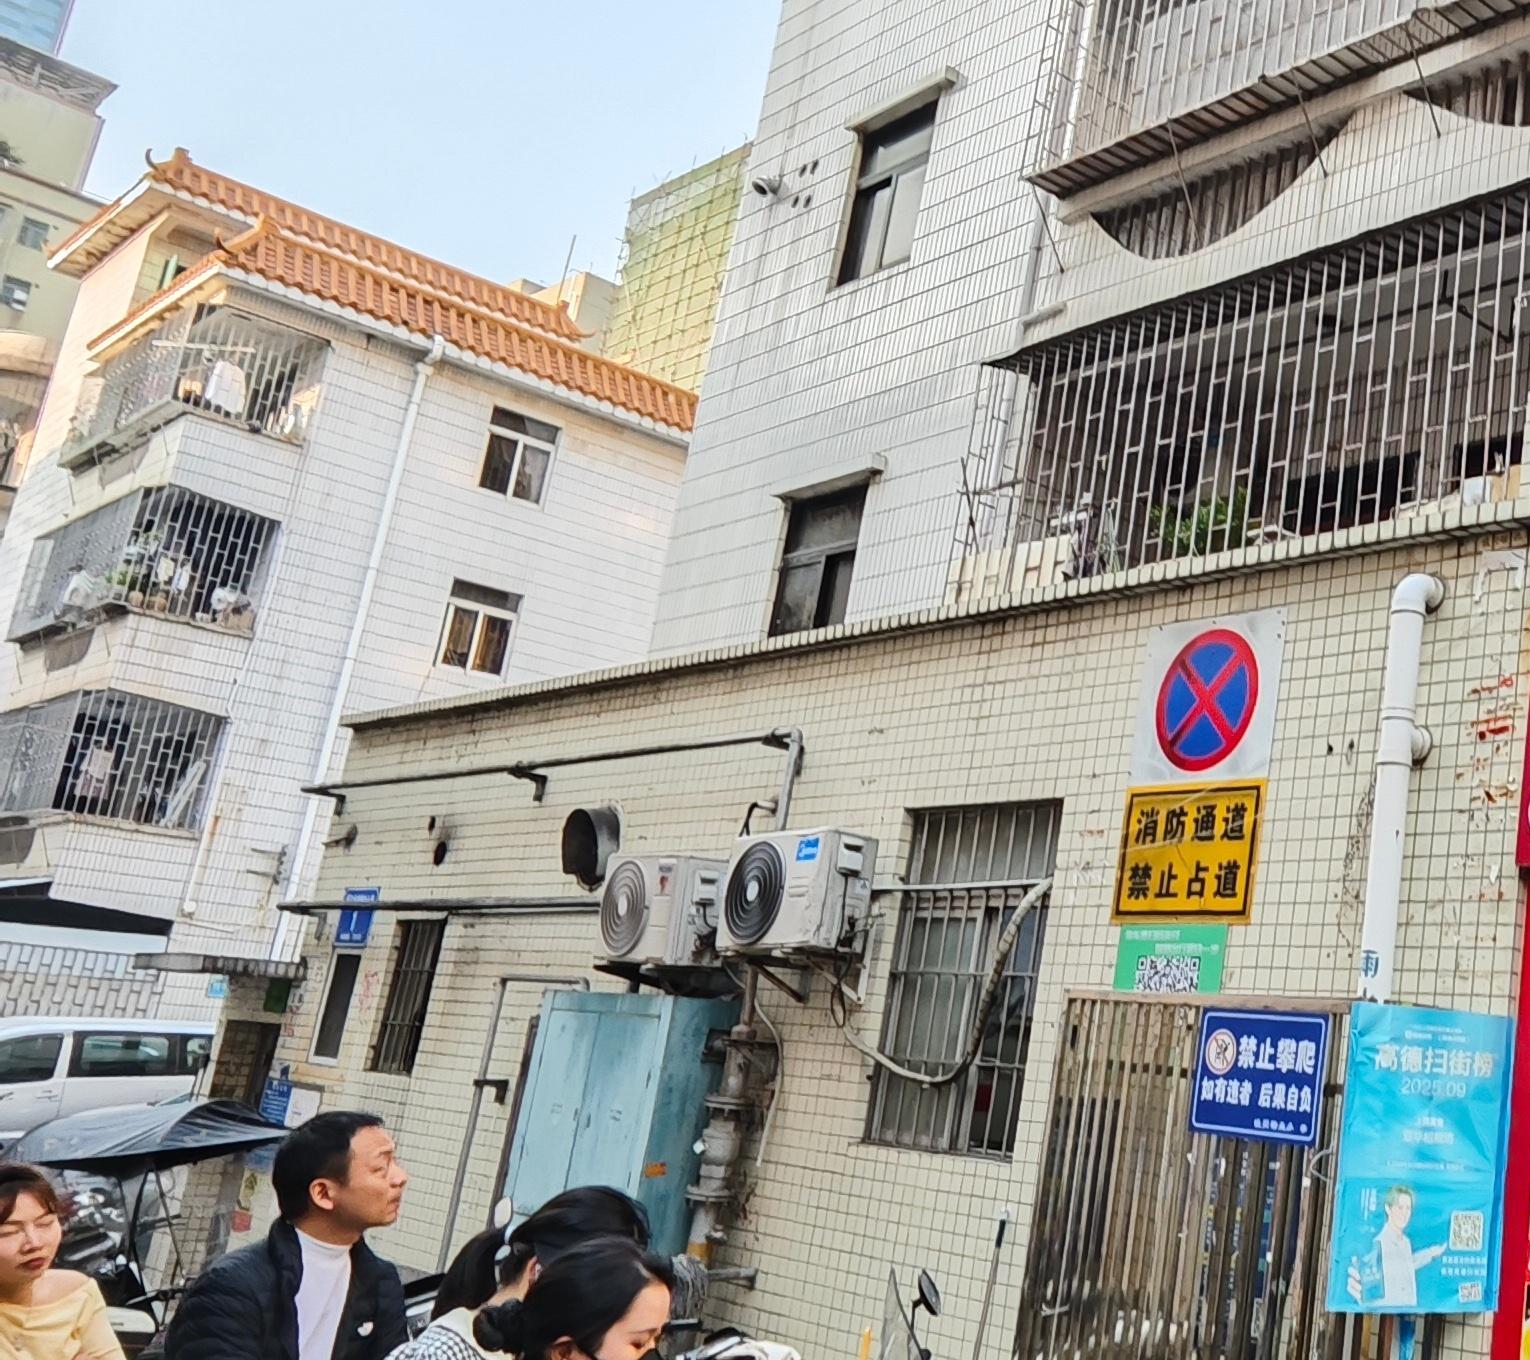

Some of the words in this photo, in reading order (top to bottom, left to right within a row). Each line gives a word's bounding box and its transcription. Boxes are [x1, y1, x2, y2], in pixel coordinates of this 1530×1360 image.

[1135, 802, 1248, 845] 消防通道
[1127, 859, 1241, 901] 禁止占道
[1237, 1034, 1317, 1075] 禁止攀爬
[1374, 1043, 1495, 1078] 高德扫街榜
[1200, 1075, 1253, 1107] 如有违者
[1258, 1081, 1312, 1114] 后果自负
[1400, 1077, 1467, 1099] 2025.09
